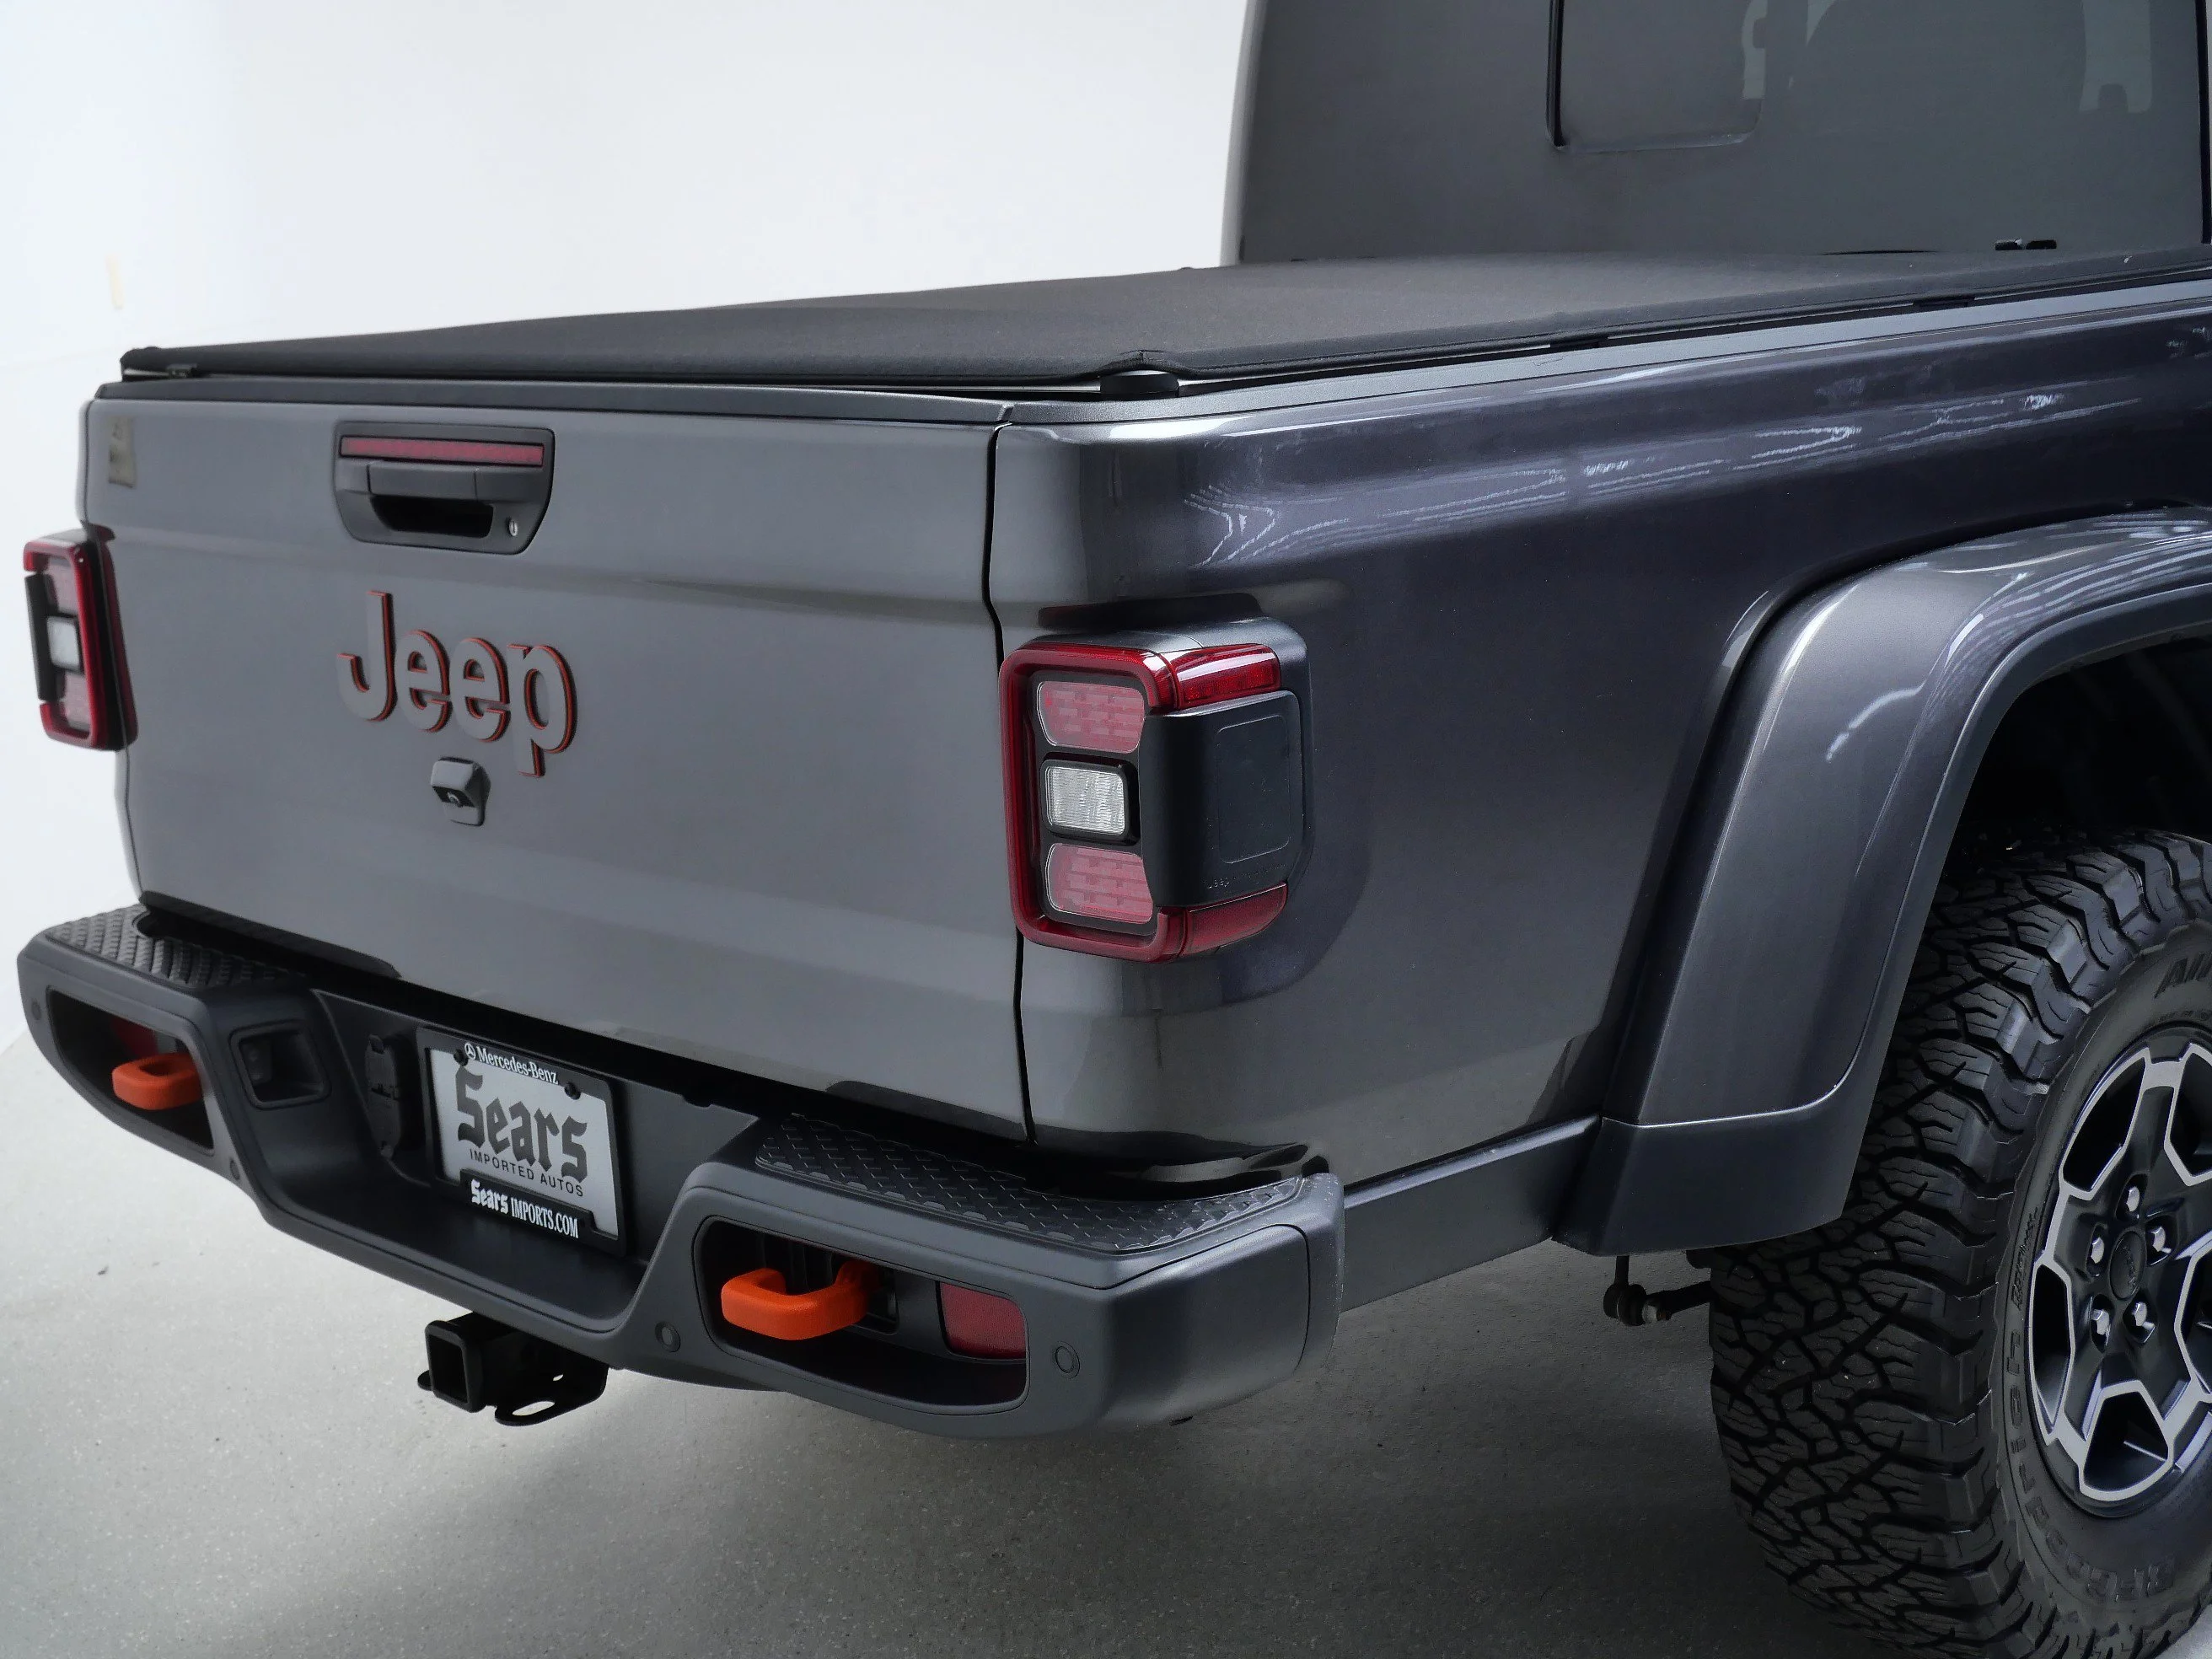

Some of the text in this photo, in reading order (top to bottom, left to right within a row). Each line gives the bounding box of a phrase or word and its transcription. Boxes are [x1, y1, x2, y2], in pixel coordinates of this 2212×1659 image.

[336, 589, 578, 779] Jeep
[475, 1045, 559, 1085] Mercedes-Benz
[455, 1066, 588, 1183] Sears
[470, 1148, 583, 1197] IMPORTED AUTOS
[470, 1178, 579, 1239] Sears IMPORTS.COM
